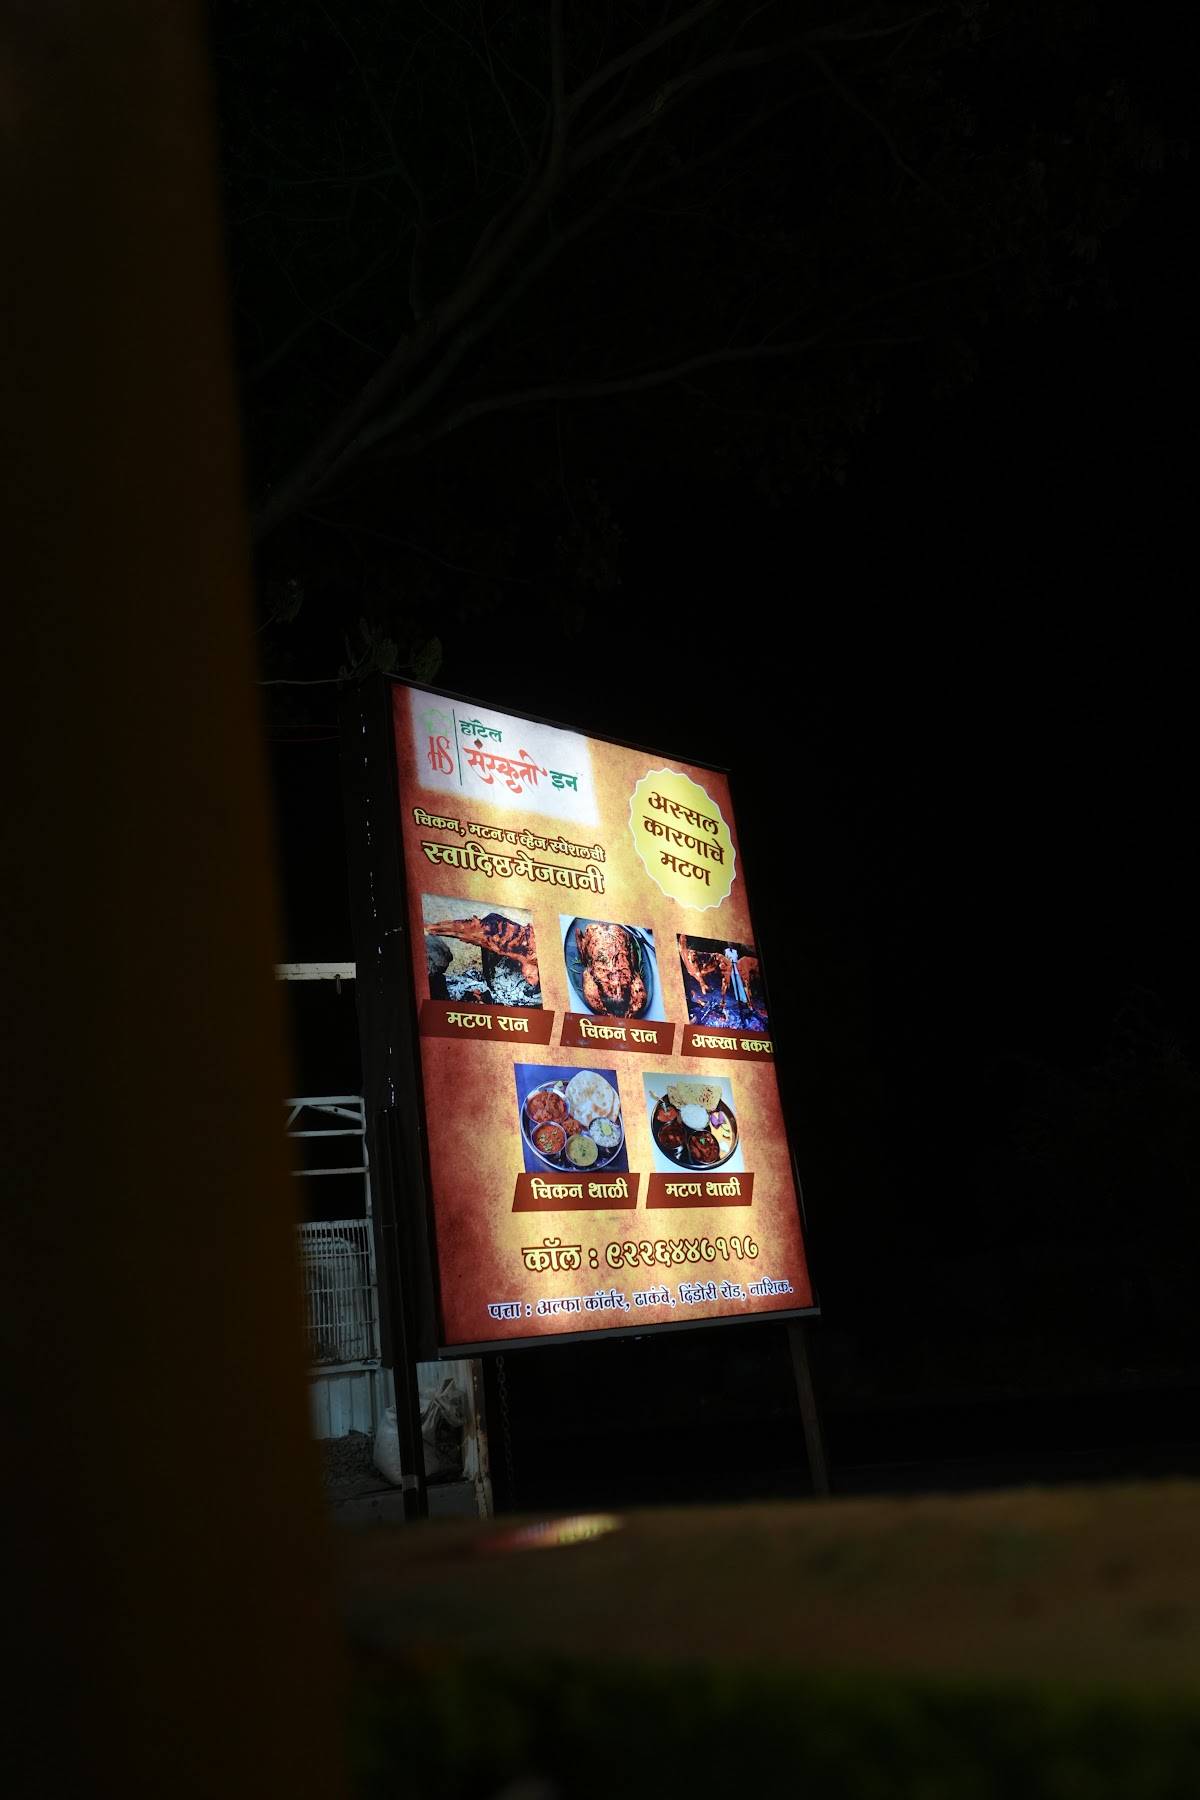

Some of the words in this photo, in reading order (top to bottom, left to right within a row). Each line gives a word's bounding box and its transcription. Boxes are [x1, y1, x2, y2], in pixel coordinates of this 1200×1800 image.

[459, 719, 502, 742] हॉटेल
[550, 770, 578, 792] इन
[648, 791, 719, 835] अस्सल
[413, 808, 466, 837] चिकन,
[468, 821, 505, 843] मटन
[504, 829, 518, 844] व
[518, 828, 548, 851] व्हेज
[643, 815, 724, 865] कारणाचे
[514, 850, 606, 894] मेजवानी
[660, 851, 711, 886] मटण
[446, 1011, 493, 1030] मटण
[497, 1015, 529, 1033] रान
[579, 1018, 626, 1042] चिकन
[630, 1028, 658, 1044] रान
[691, 1033, 738, 1051] अख्खा
[531, 1177, 583, 1200] चिकन
[588, 1177, 629, 1199] थाळी
[664, 1182, 701, 1198] मटण
[705, 1177, 742, 1197] थाळी
[521, 1237, 582, 1272] कॉल
[605, 1235, 759, 1269] ९२२६४४७११७
[488, 1302, 521, 1320] पत्ता
[536, 1297, 581, 1317] अल्फा
[584, 1288, 631, 1312] कॉर्नर,
[633, 1285, 676, 1308] ढाकंबे,
[679, 1280, 718, 1305] दिंडोरी
[720, 1280, 747, 1299] रोड,
[749, 1276, 793, 1297] नाशिक.
